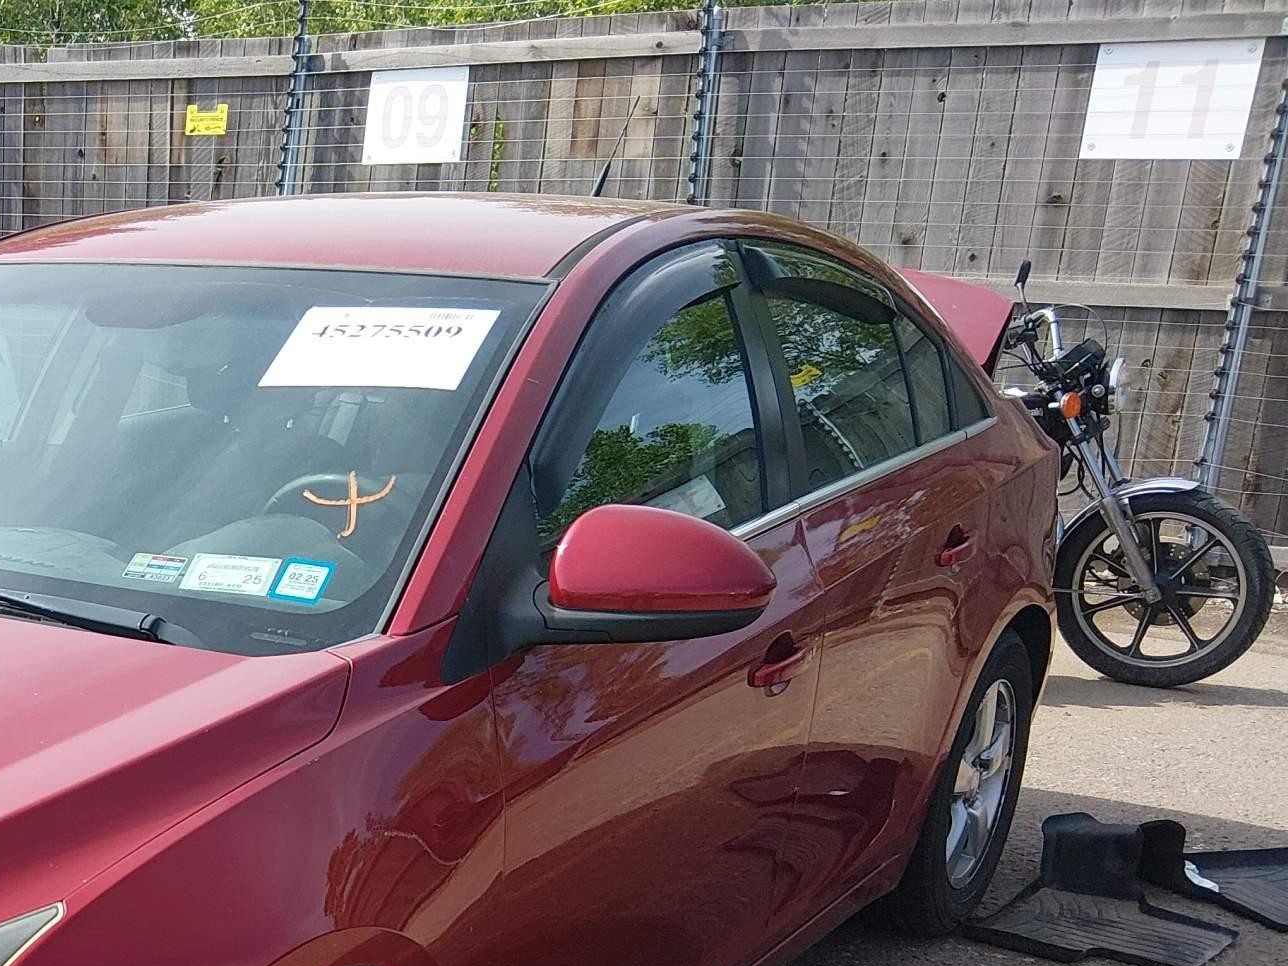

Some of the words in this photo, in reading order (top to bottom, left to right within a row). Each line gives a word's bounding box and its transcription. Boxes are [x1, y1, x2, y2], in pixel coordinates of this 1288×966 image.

[381, 84, 449, 150] 09
[1124, 59, 1220, 140] 11
[311, 323, 464, 339] 45275509
